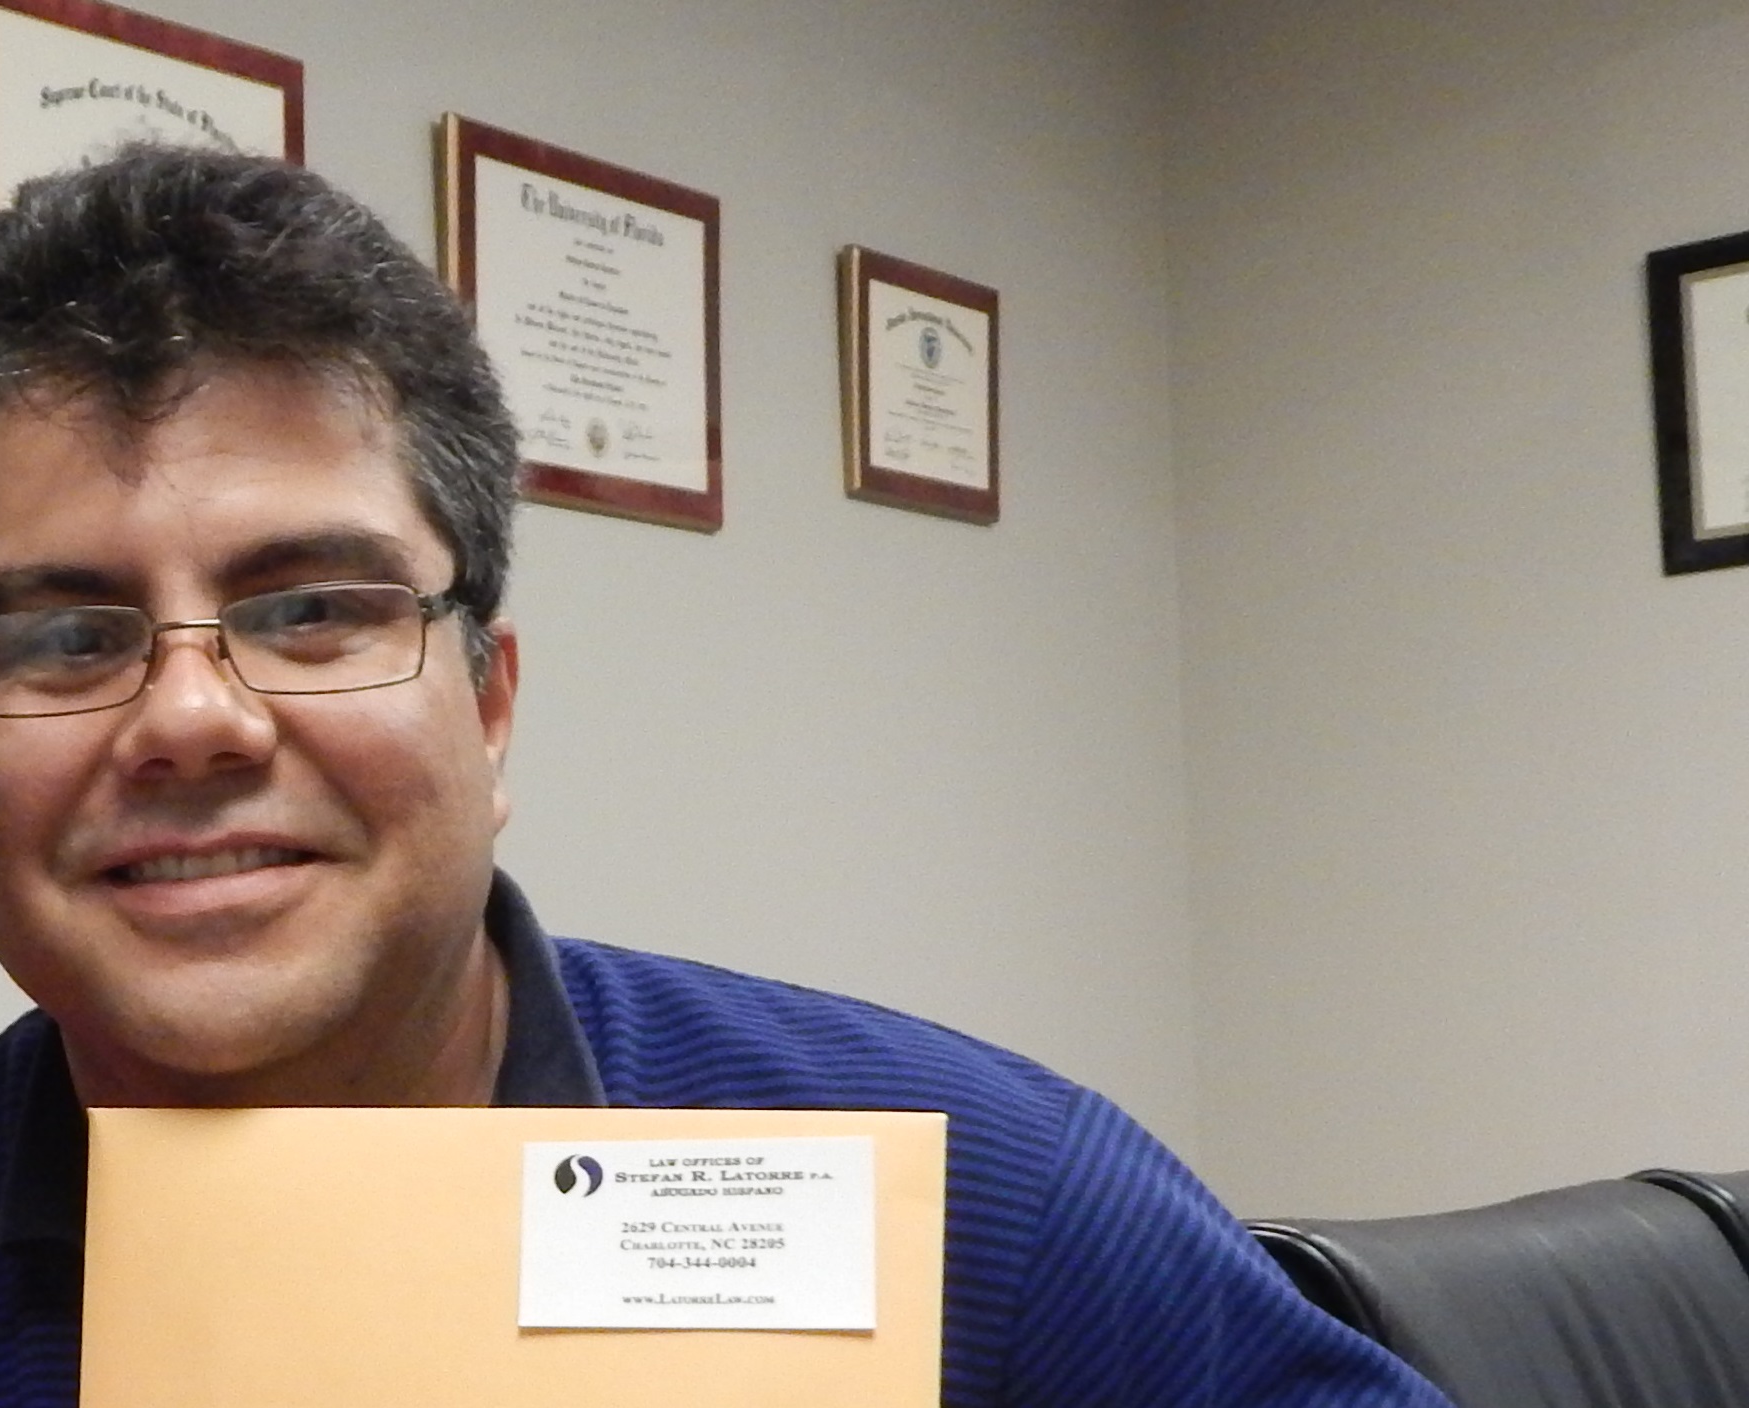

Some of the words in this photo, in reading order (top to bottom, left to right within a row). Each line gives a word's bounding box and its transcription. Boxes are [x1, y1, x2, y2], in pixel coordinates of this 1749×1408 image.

[649, 1158, 678, 1168] LAW
[682, 1157, 741, 1167] OFFICES
[745, 1156, 764, 1166] OF
[614, 1171, 683, 1183] STEFAN
[691, 1170, 713, 1182] R.
[720, 1169, 804, 1182] LATORRE
[620, 1221, 657, 1234] 2629
[660, 1221, 724, 1233] CENTRAL
[728, 1221, 785, 1233] AVENUE
[619, 1238, 707, 1252] CHARLOTTE,
[710, 1238, 737, 1251] NC
[741, 1237, 786, 1250] 28205
[646, 1255, 757, 1269] 704-344-0004
